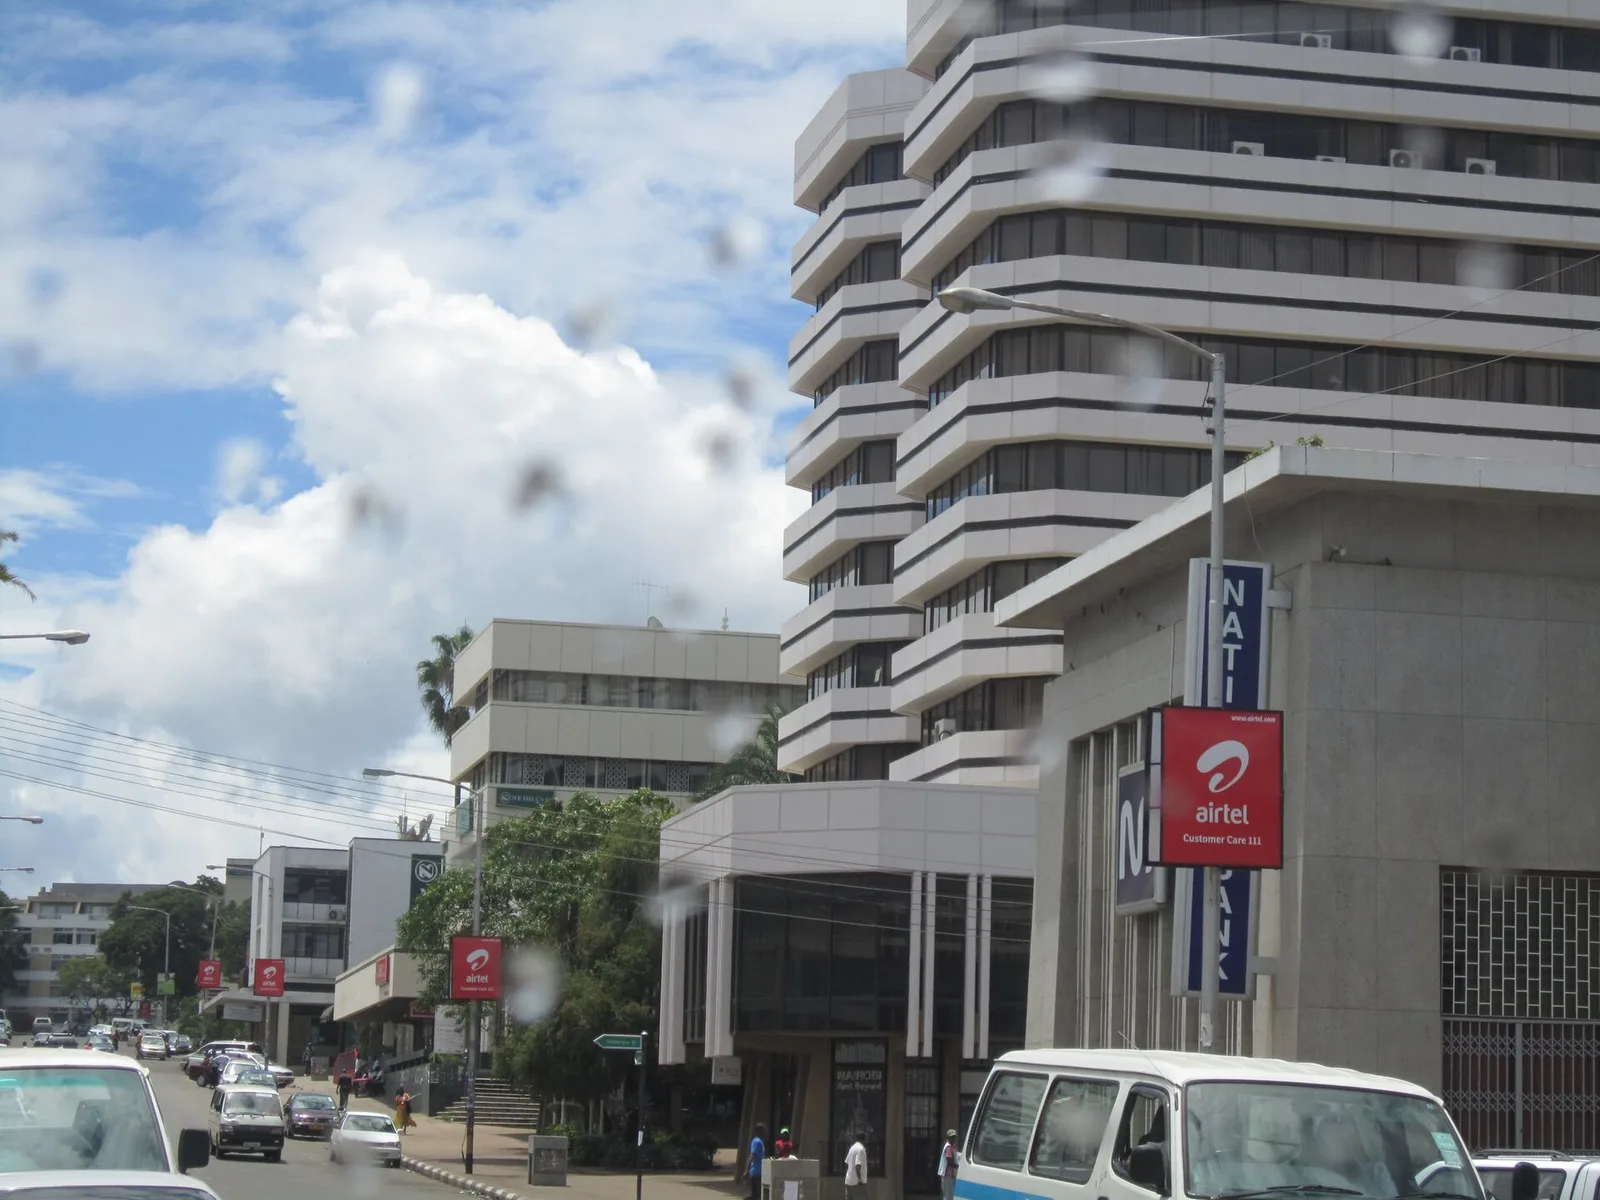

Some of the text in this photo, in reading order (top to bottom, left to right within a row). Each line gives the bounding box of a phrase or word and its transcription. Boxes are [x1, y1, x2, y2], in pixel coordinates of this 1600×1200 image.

[1222, 578, 1244, 703] NATI
[1231, 715, 1276, 723] www.airtel.com
[1196, 801, 1249, 825] airtel
[1183, 833, 1262, 846] Customer Care 111
[466, 974, 489, 984] airtel
[837, 1070, 882, 1081] NAIROBI
